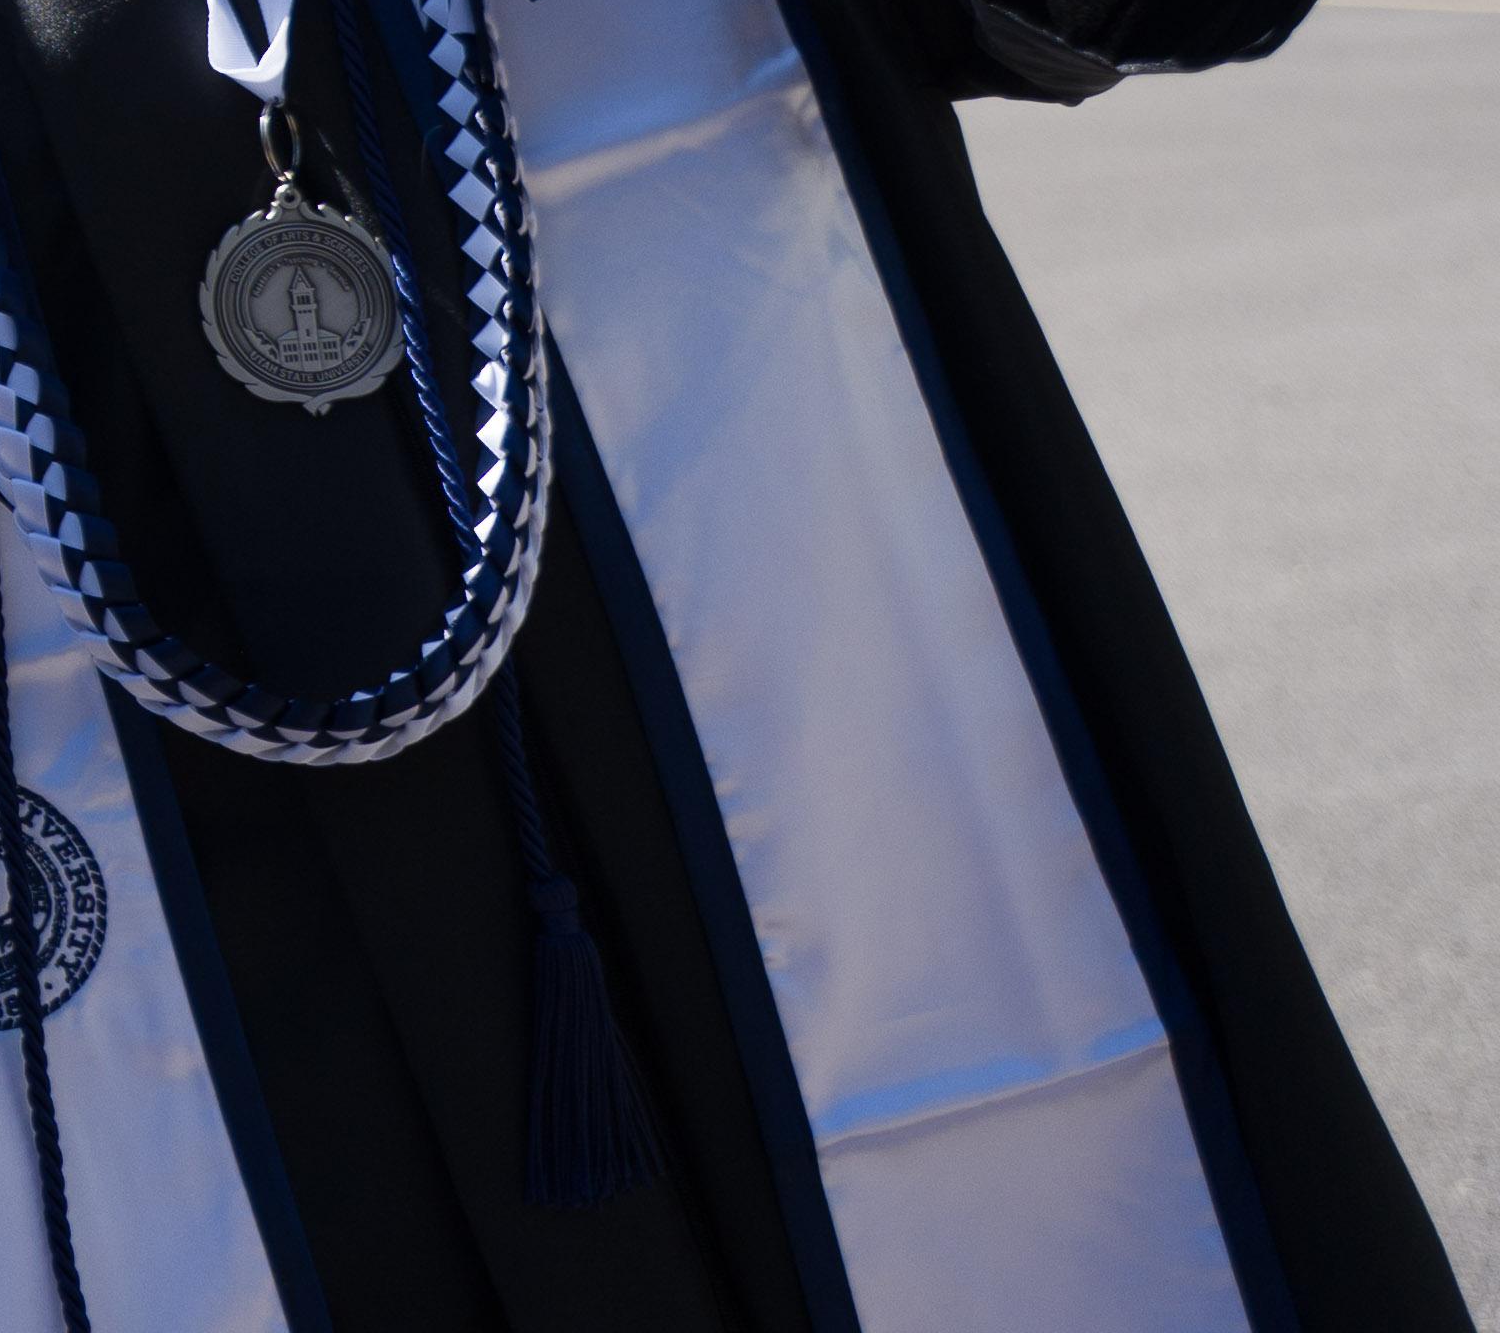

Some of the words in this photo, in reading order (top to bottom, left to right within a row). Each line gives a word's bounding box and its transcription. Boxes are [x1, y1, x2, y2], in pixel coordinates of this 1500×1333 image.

[231, 244, 265, 283] COLLEGE
[264, 236, 279, 247] OF
[281, 231, 310, 241] ARTS
[323, 236, 370, 274] SCIENCES
[249, 350, 277, 375] UTAH
[279, 369, 315, 383] STATE
[316, 343, 371, 383] UNIVERSITY
